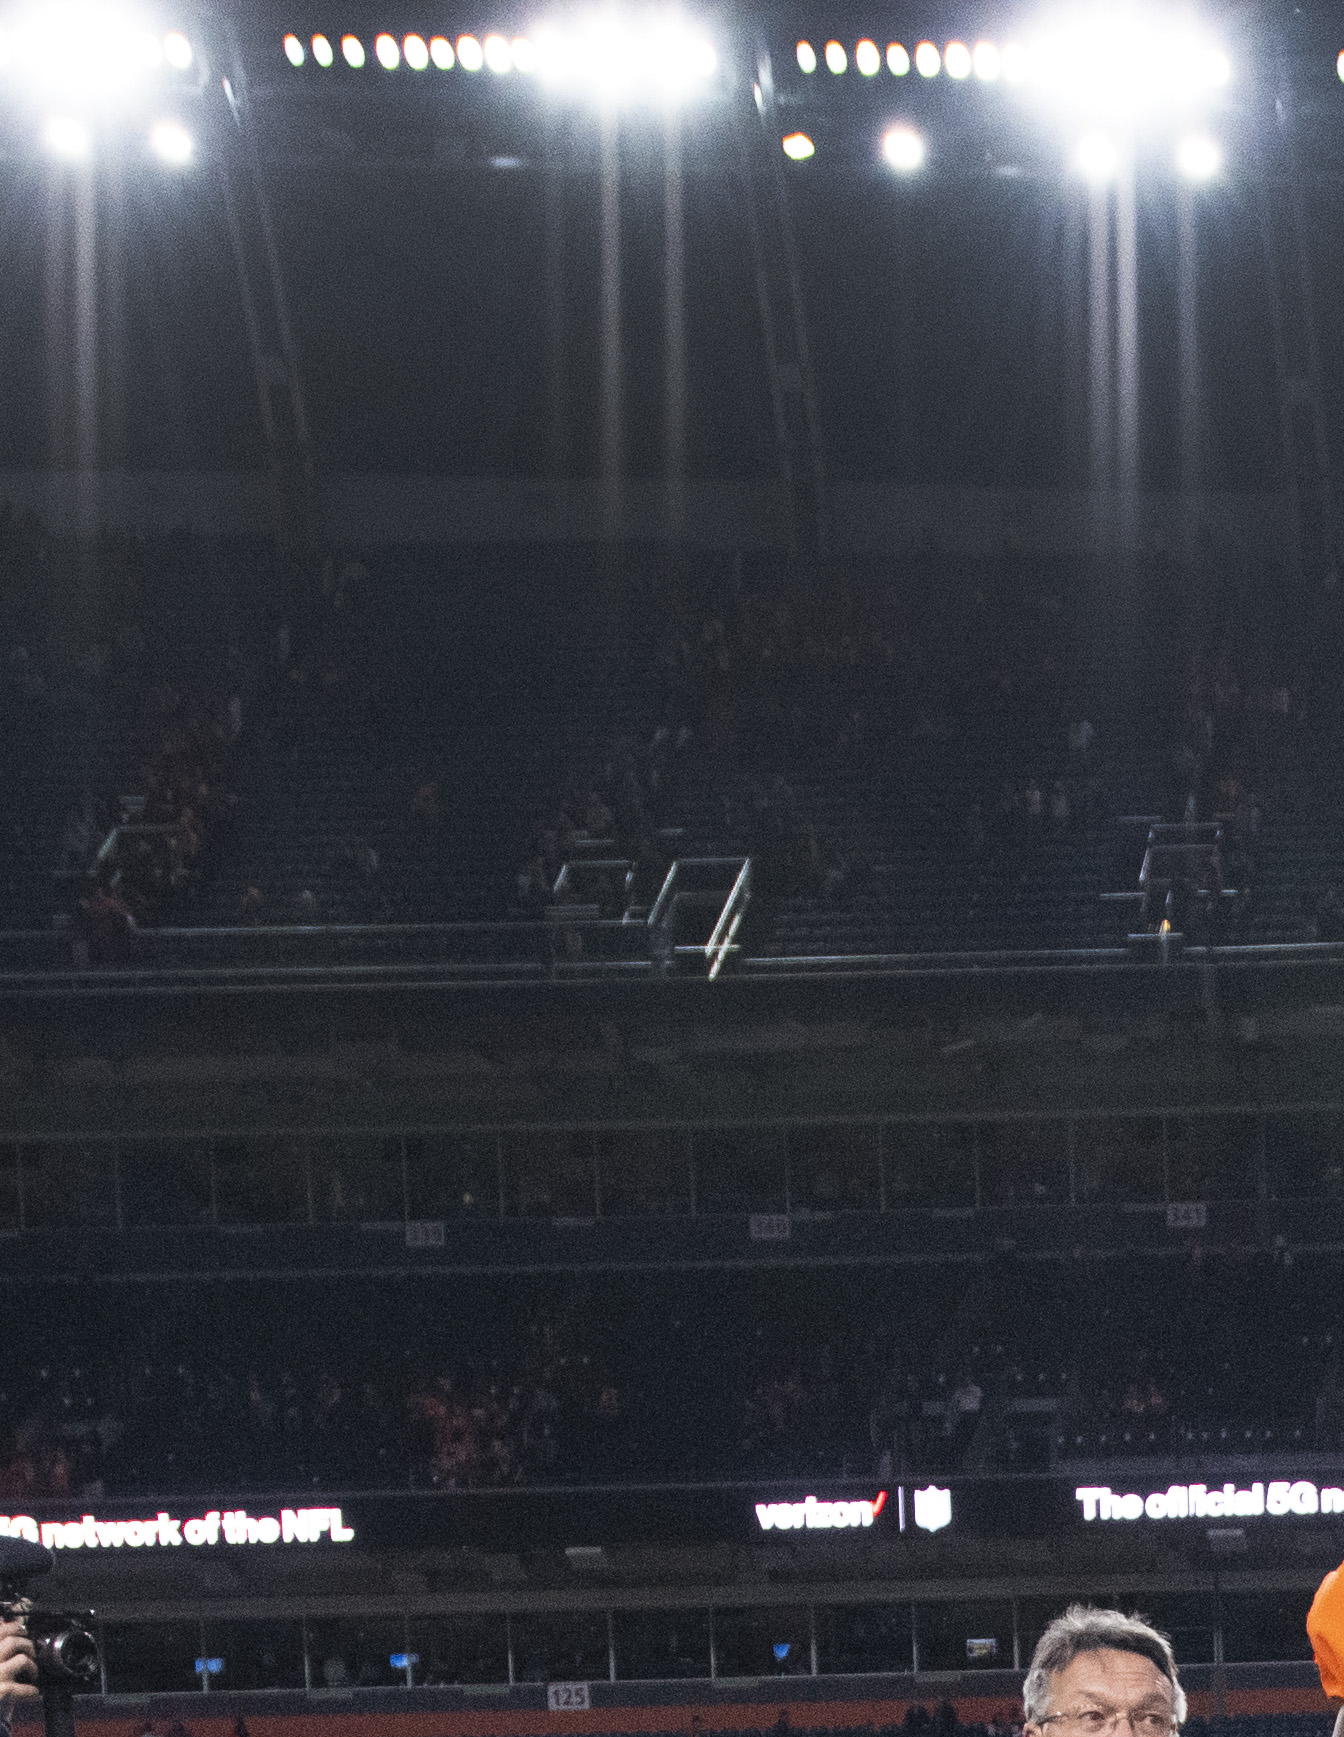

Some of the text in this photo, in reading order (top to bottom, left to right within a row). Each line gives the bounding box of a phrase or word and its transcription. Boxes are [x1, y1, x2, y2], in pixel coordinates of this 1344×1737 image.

[755, 1495, 875, 1530] verizon
[1075, 1486, 1143, 1520] The
[1145, 1482, 1265, 1518] official
[1265, 1480, 1318, 1515] 5G
[39, 1511, 183, 1549] network
[182, 1511, 221, 1545] of
[221, 1510, 281, 1544] the
[280, 1508, 355, 1543] NFL
[553, 1687, 586, 1707] 125
